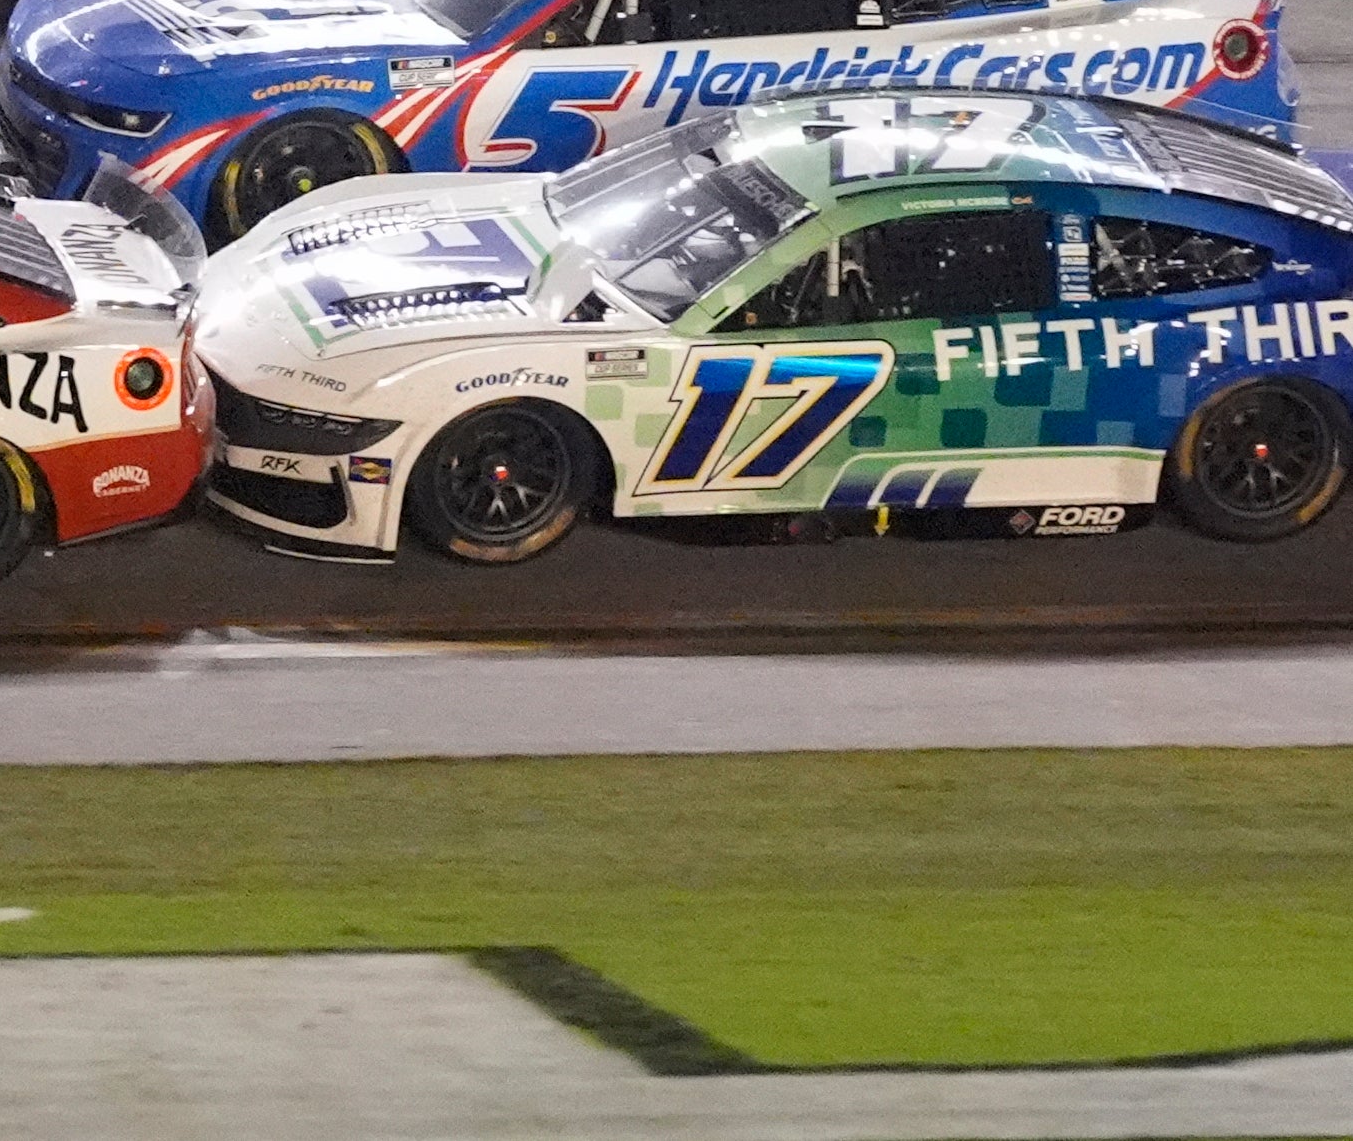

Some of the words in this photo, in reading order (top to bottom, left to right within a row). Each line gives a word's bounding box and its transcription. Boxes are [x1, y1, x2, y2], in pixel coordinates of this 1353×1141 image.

[250, 75, 375, 101] GOODYEAR
[480, 64, 642, 172] 5
[932, 316, 1156, 382] FIFTH
[1187, 299, 1353, 365] THIR
[255, 362, 297, 380] FIFTH
[302, 369, 348, 393] THIRD
[455, 367, 570, 394] GOODYEAR
[631, 338, 896, 498] 17
[93, 464, 151, 492] BONANZA
[1034, 524, 1120, 536] PERFORMANCE
[1038, 506, 1126, 526] FORD
